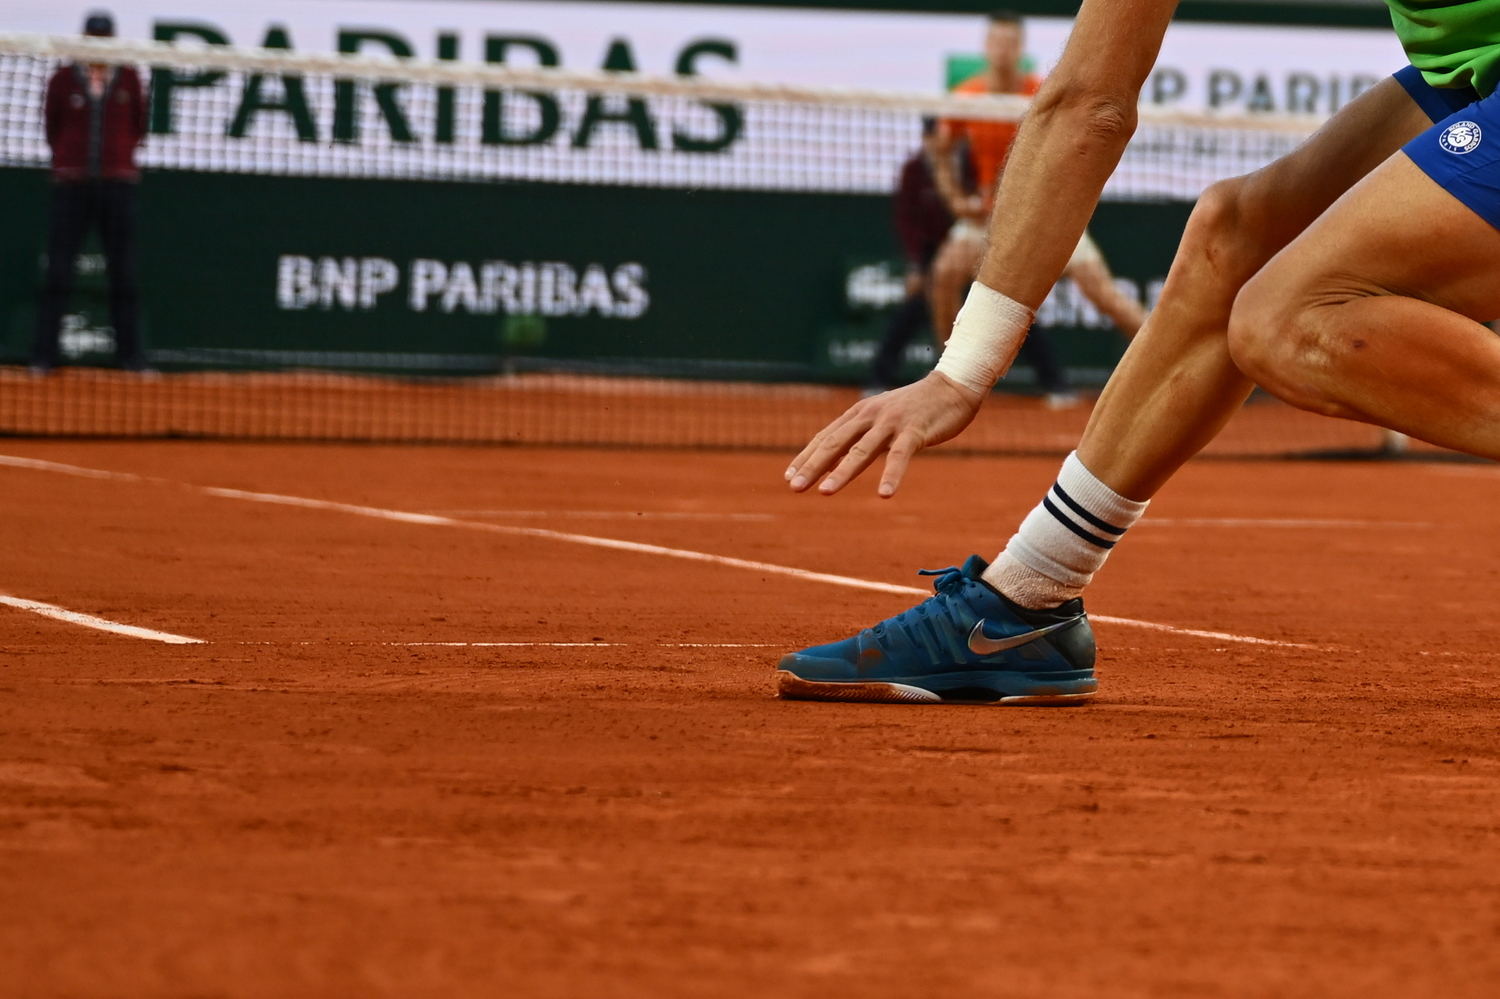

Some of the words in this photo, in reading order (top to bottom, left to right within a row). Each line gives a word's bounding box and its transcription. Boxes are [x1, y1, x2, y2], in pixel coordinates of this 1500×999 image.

[150, 19, 744, 153] PARIBAS
[277, 254, 398, 311] BNP
[407, 258, 650, 320] PARIBAS
